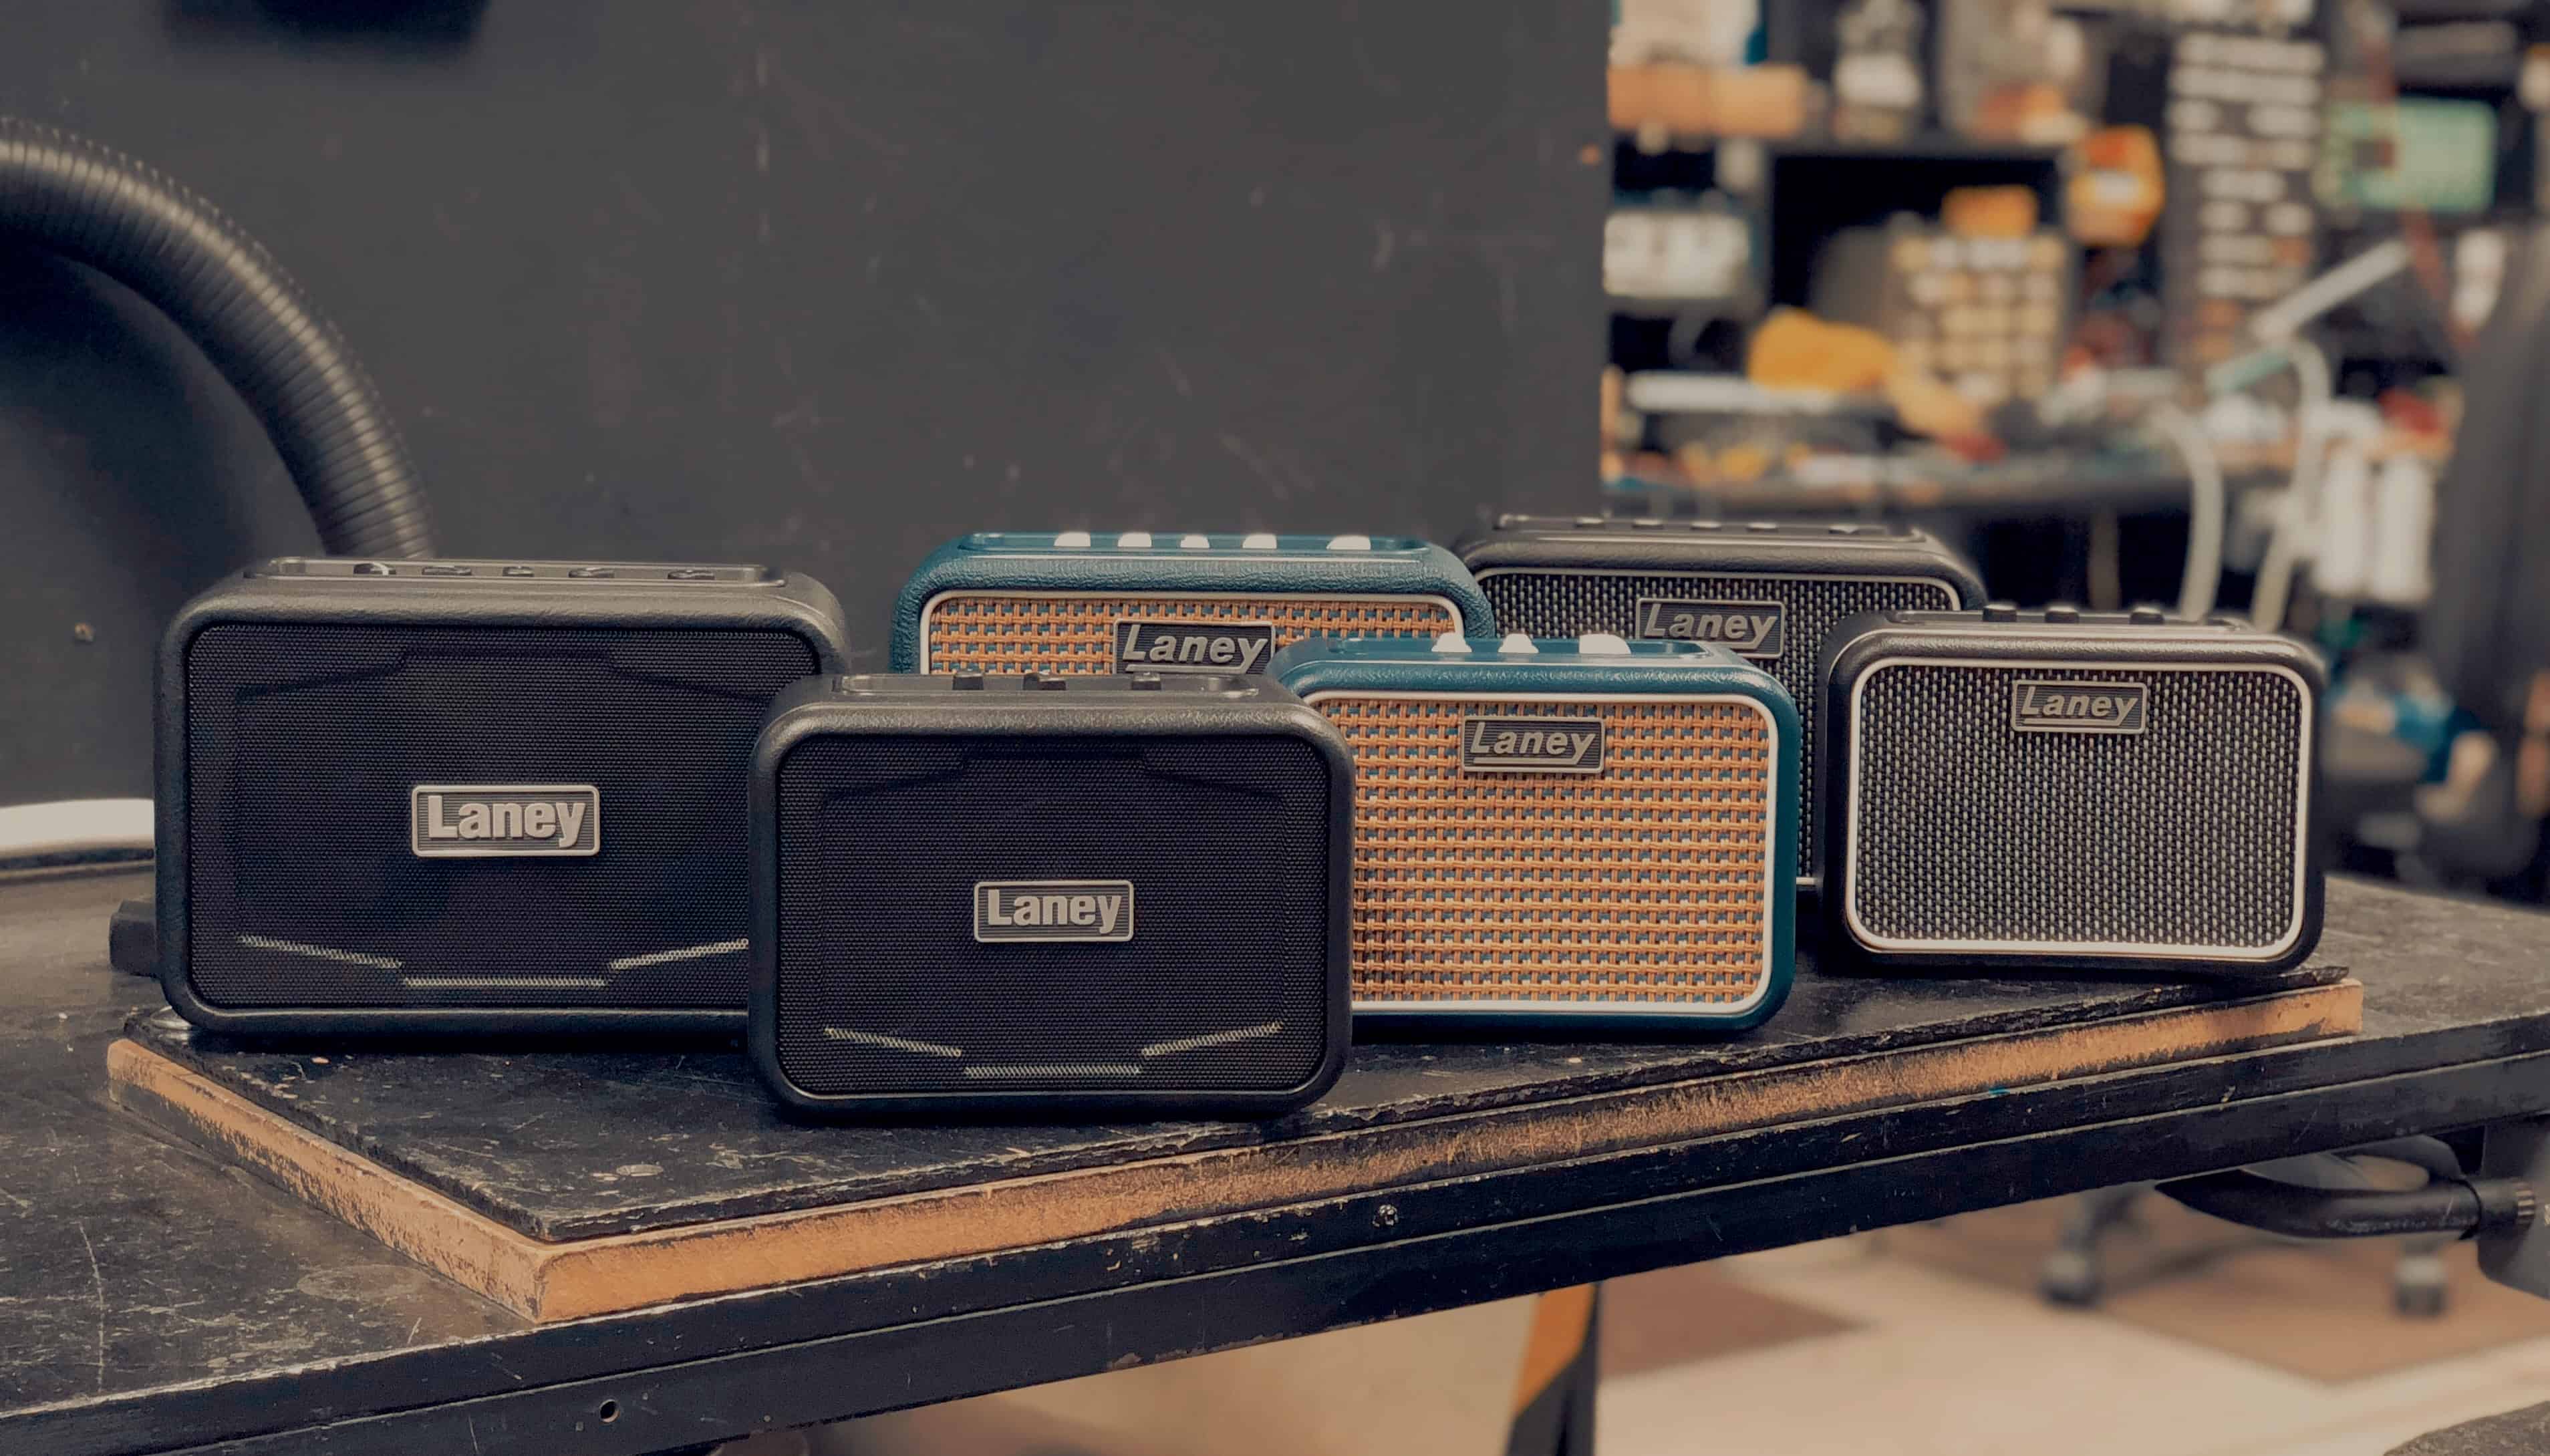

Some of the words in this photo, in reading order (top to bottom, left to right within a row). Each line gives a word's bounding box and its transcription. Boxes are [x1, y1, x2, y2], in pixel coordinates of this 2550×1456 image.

[1645, 603, 1778, 649] Laney
[1123, 624, 1268, 674] Laney
[2021, 686, 2138, 726] Laney
[1471, 722, 1596, 764] Laney
[428, 795, 586, 848] Laney
[988, 889, 1121, 934] Laney
